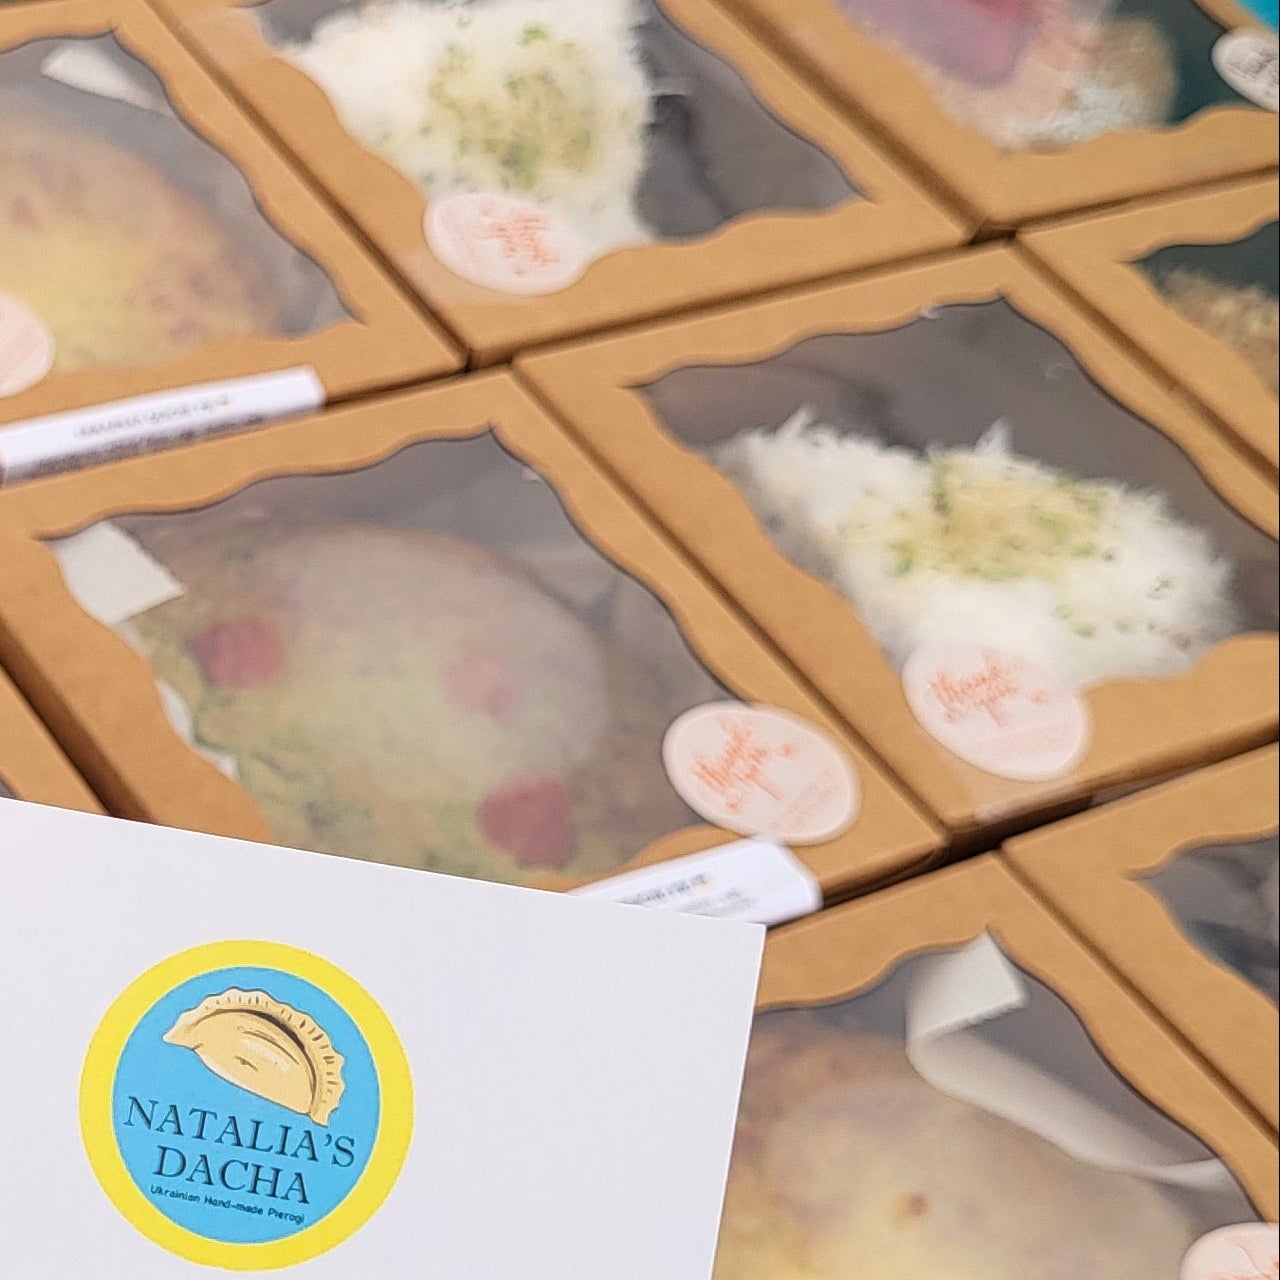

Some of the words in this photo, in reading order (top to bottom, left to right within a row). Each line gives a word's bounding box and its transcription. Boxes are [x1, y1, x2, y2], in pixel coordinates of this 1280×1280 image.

[123, 1096, 356, 1168] NATALIA'S
[153, 1145, 310, 1204] DACHA
[149, 1184, 200, 1203] Ukrainian
[204, 1196, 264, 1216] Hand-made
[268, 1207, 306, 1225] Pierogi
